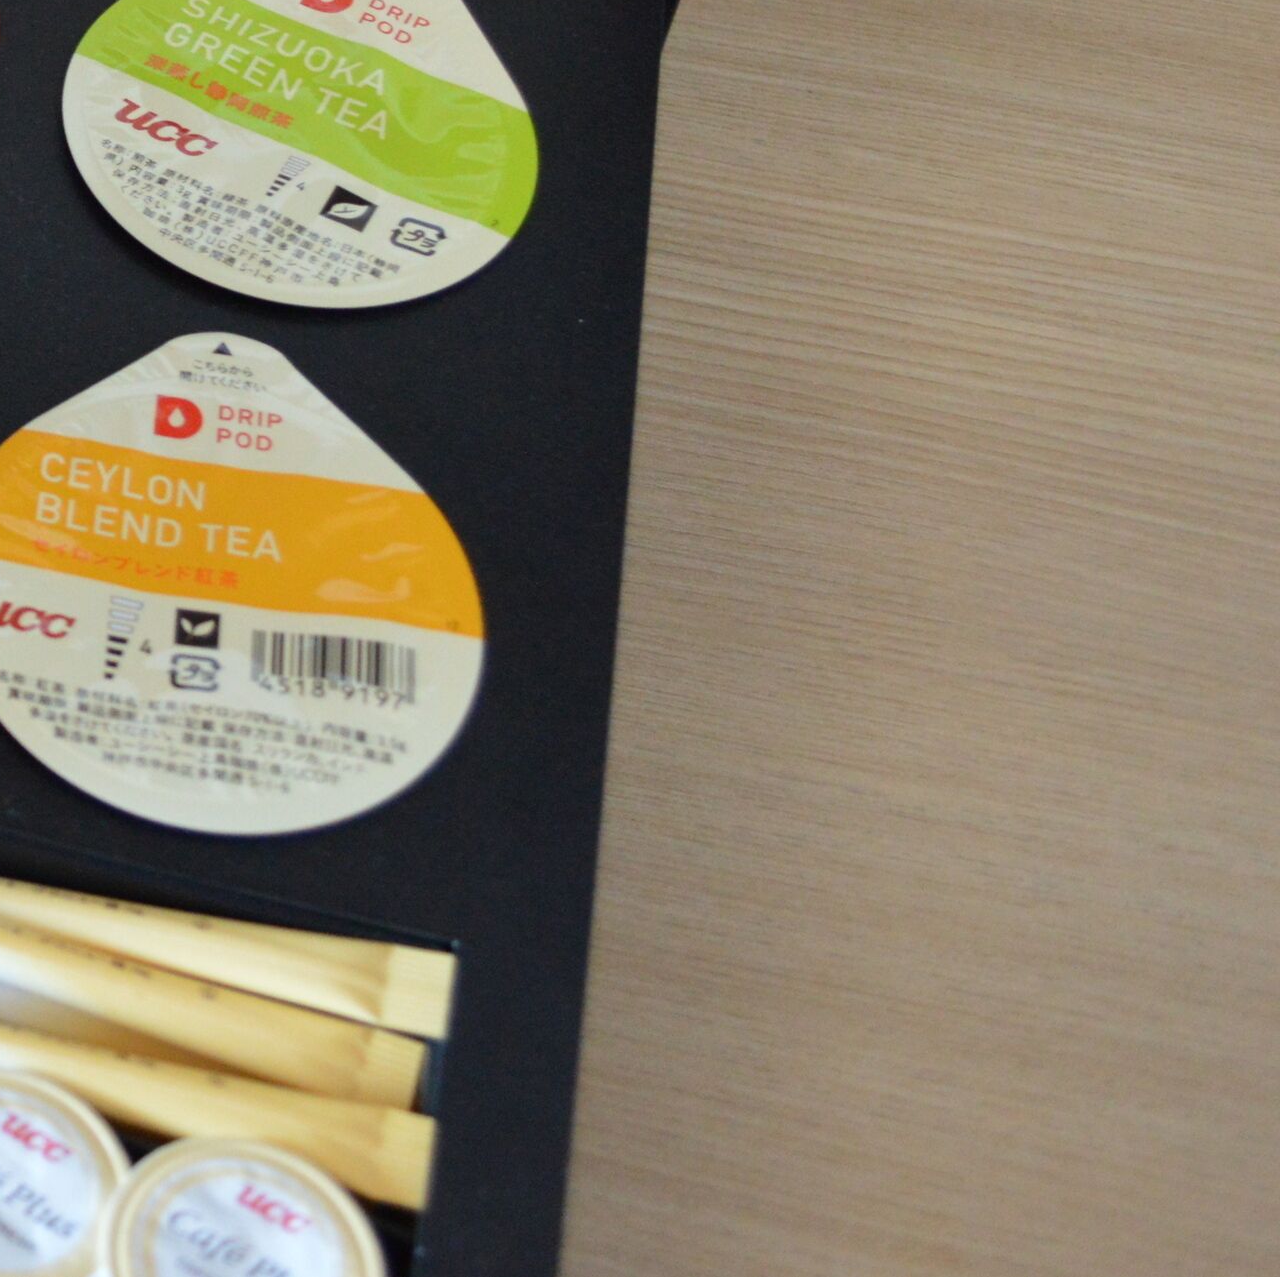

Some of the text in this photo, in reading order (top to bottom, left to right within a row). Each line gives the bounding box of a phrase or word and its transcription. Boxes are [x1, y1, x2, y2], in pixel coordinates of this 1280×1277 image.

[358, 12, 412, 44] POD
[163, 23, 388, 140] GREEN TEA
[216, 404, 284, 429] DRIP
[215, 427, 274, 453] POD
[39, 453, 208, 512] CEYLON
[35, 492, 284, 563] BLEND TEA
[140, 640, 153, 656] 4
[258, 674, 407, 710] 4518 9197
[4, 1180, 77, 1240] Plus
